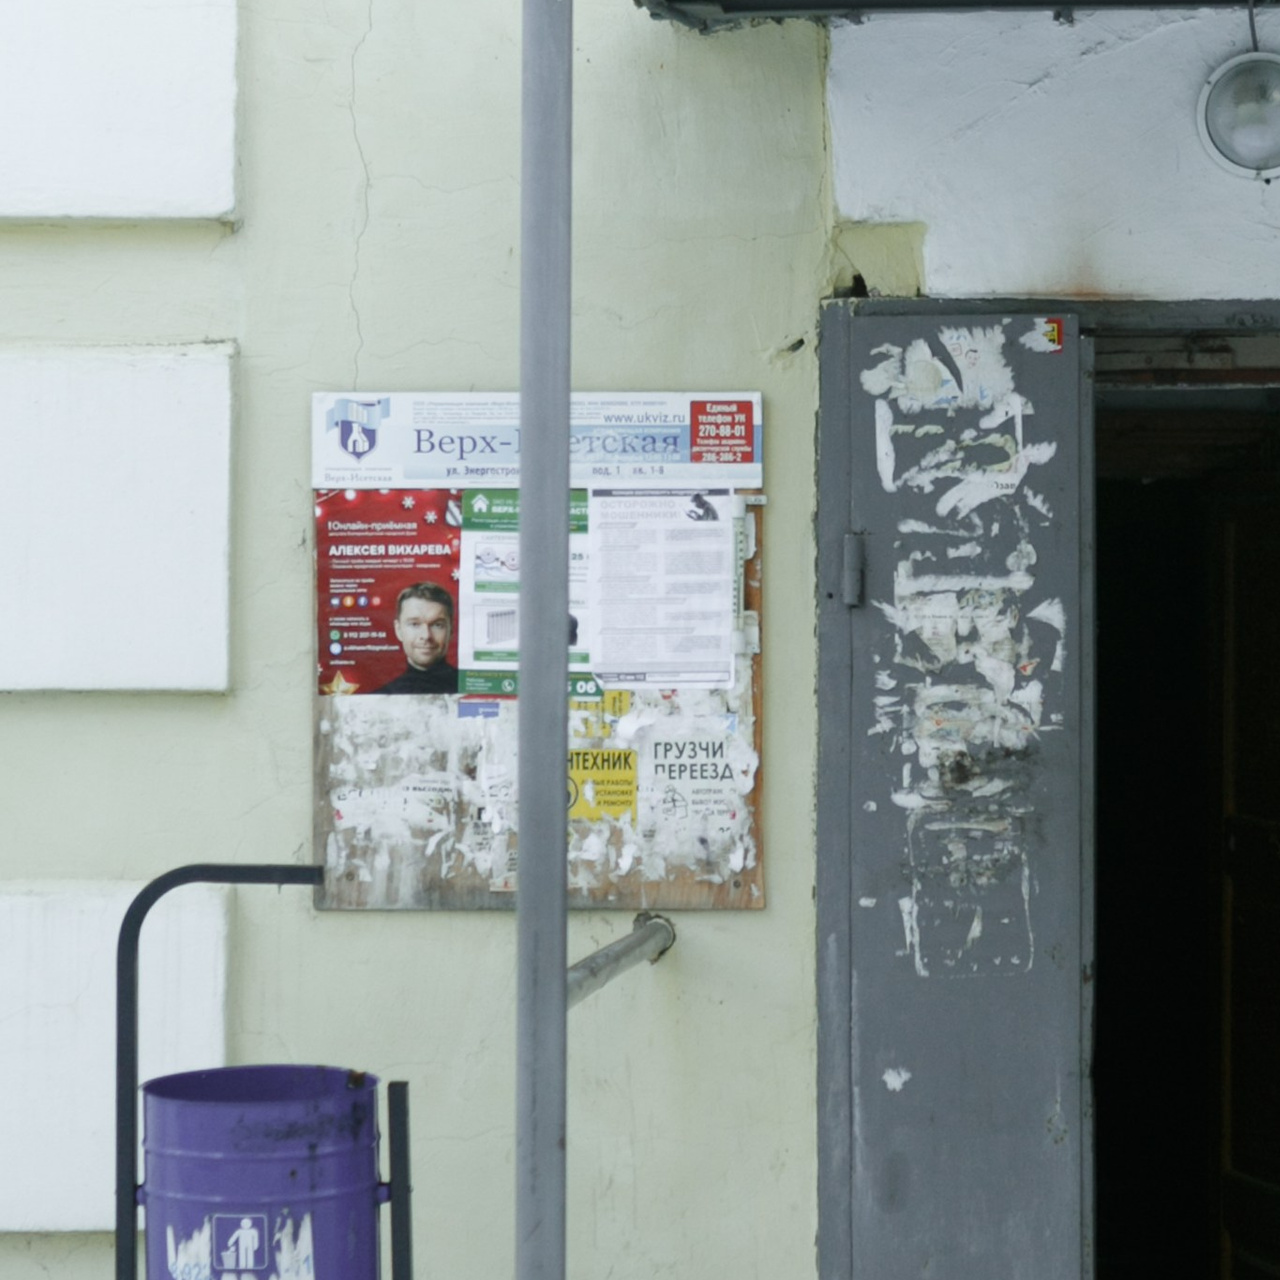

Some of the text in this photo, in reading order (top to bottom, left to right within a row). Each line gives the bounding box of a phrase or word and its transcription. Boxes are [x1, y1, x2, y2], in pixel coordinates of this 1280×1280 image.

[604, 412, 686, 424] www.ukviz.ru
[413, 428, 680, 461] Верх-етская
[446, 466, 461, 477] ул.
[599, 500, 676, 510] ОСТОРОЖНО
[328, 544, 452, 556] АЛЕКСЕЯ ВИХАРЕВА
[653, 741, 724, 760] ГРУЗЧИ
[566, 752, 632, 771] НТЕХНИК
